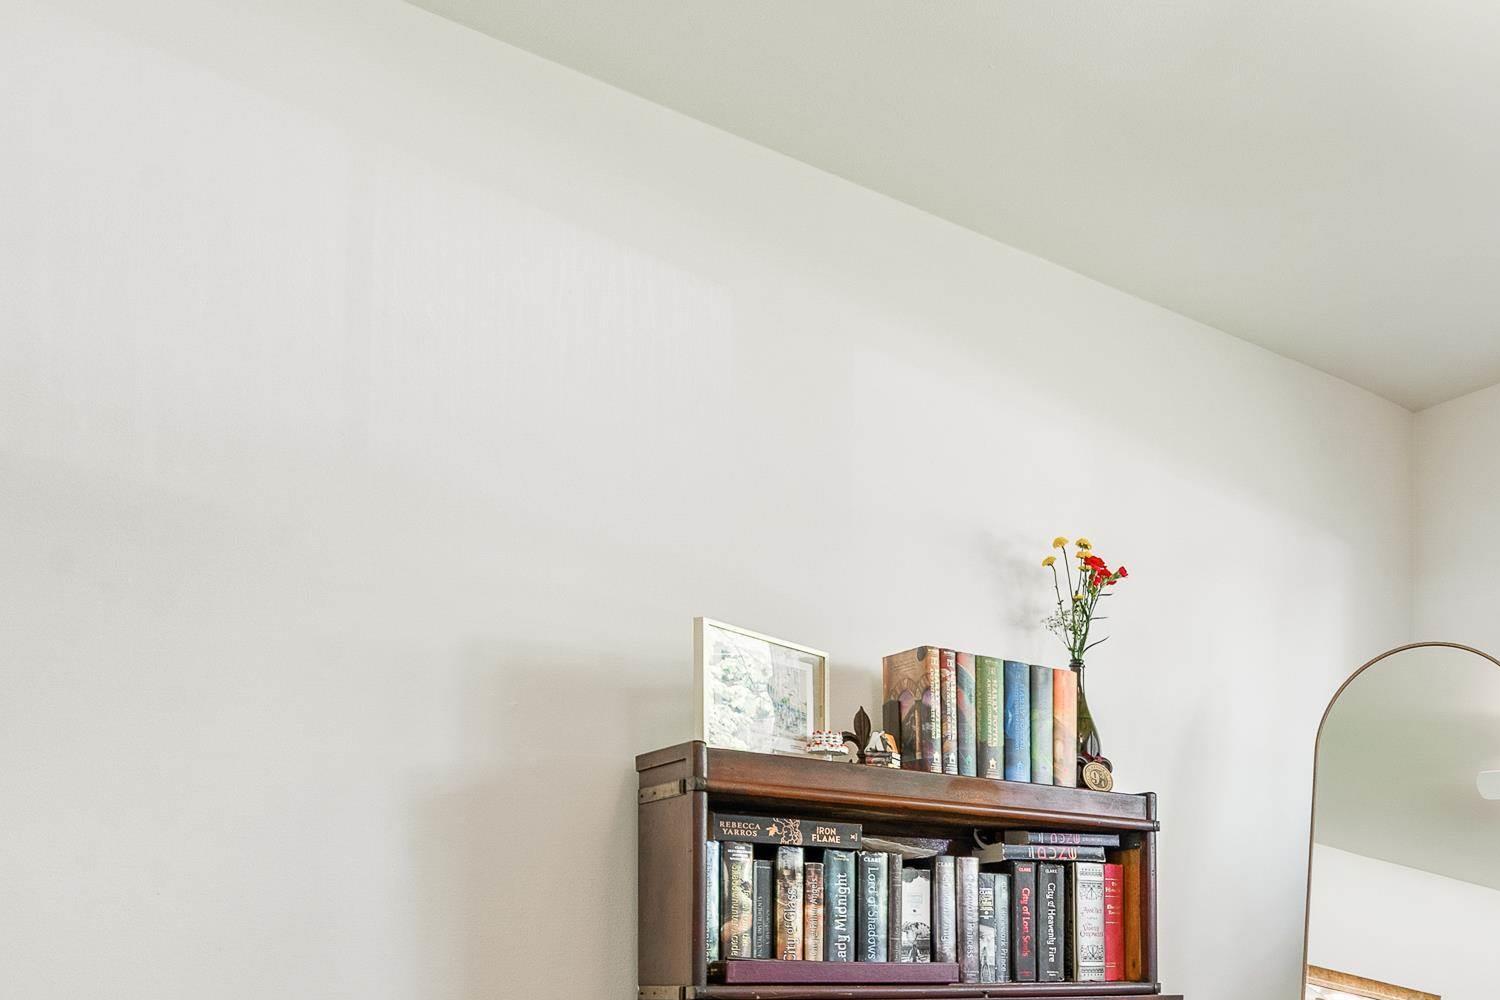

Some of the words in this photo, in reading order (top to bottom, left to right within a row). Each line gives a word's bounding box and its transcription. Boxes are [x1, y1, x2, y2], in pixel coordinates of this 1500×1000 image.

[720, 820, 760, 830] REBECCA
[722, 828, 757, 836] YARROS
[816, 826, 836, 835] IRON
[811, 834, 840, 843] FLAME
[868, 867, 878, 894] Lord
[1020, 888, 1030, 904] City
[1046, 883, 1056, 900] City
[784, 888, 797, 922] Glass
[834, 873, 850, 931] Midnight
[867, 896, 878, 908] of
[1023, 906, 1030, 915] of
[784, 924, 793, 934] of
[1022, 917, 1030, 933] Lost
[1046, 909, 1056, 944] Heavenly
[868, 910, 878, 960] Shadows
[967, 922, 977, 958] Princess
[784, 938, 798, 960] City
[835, 935, 850, 962] ady
